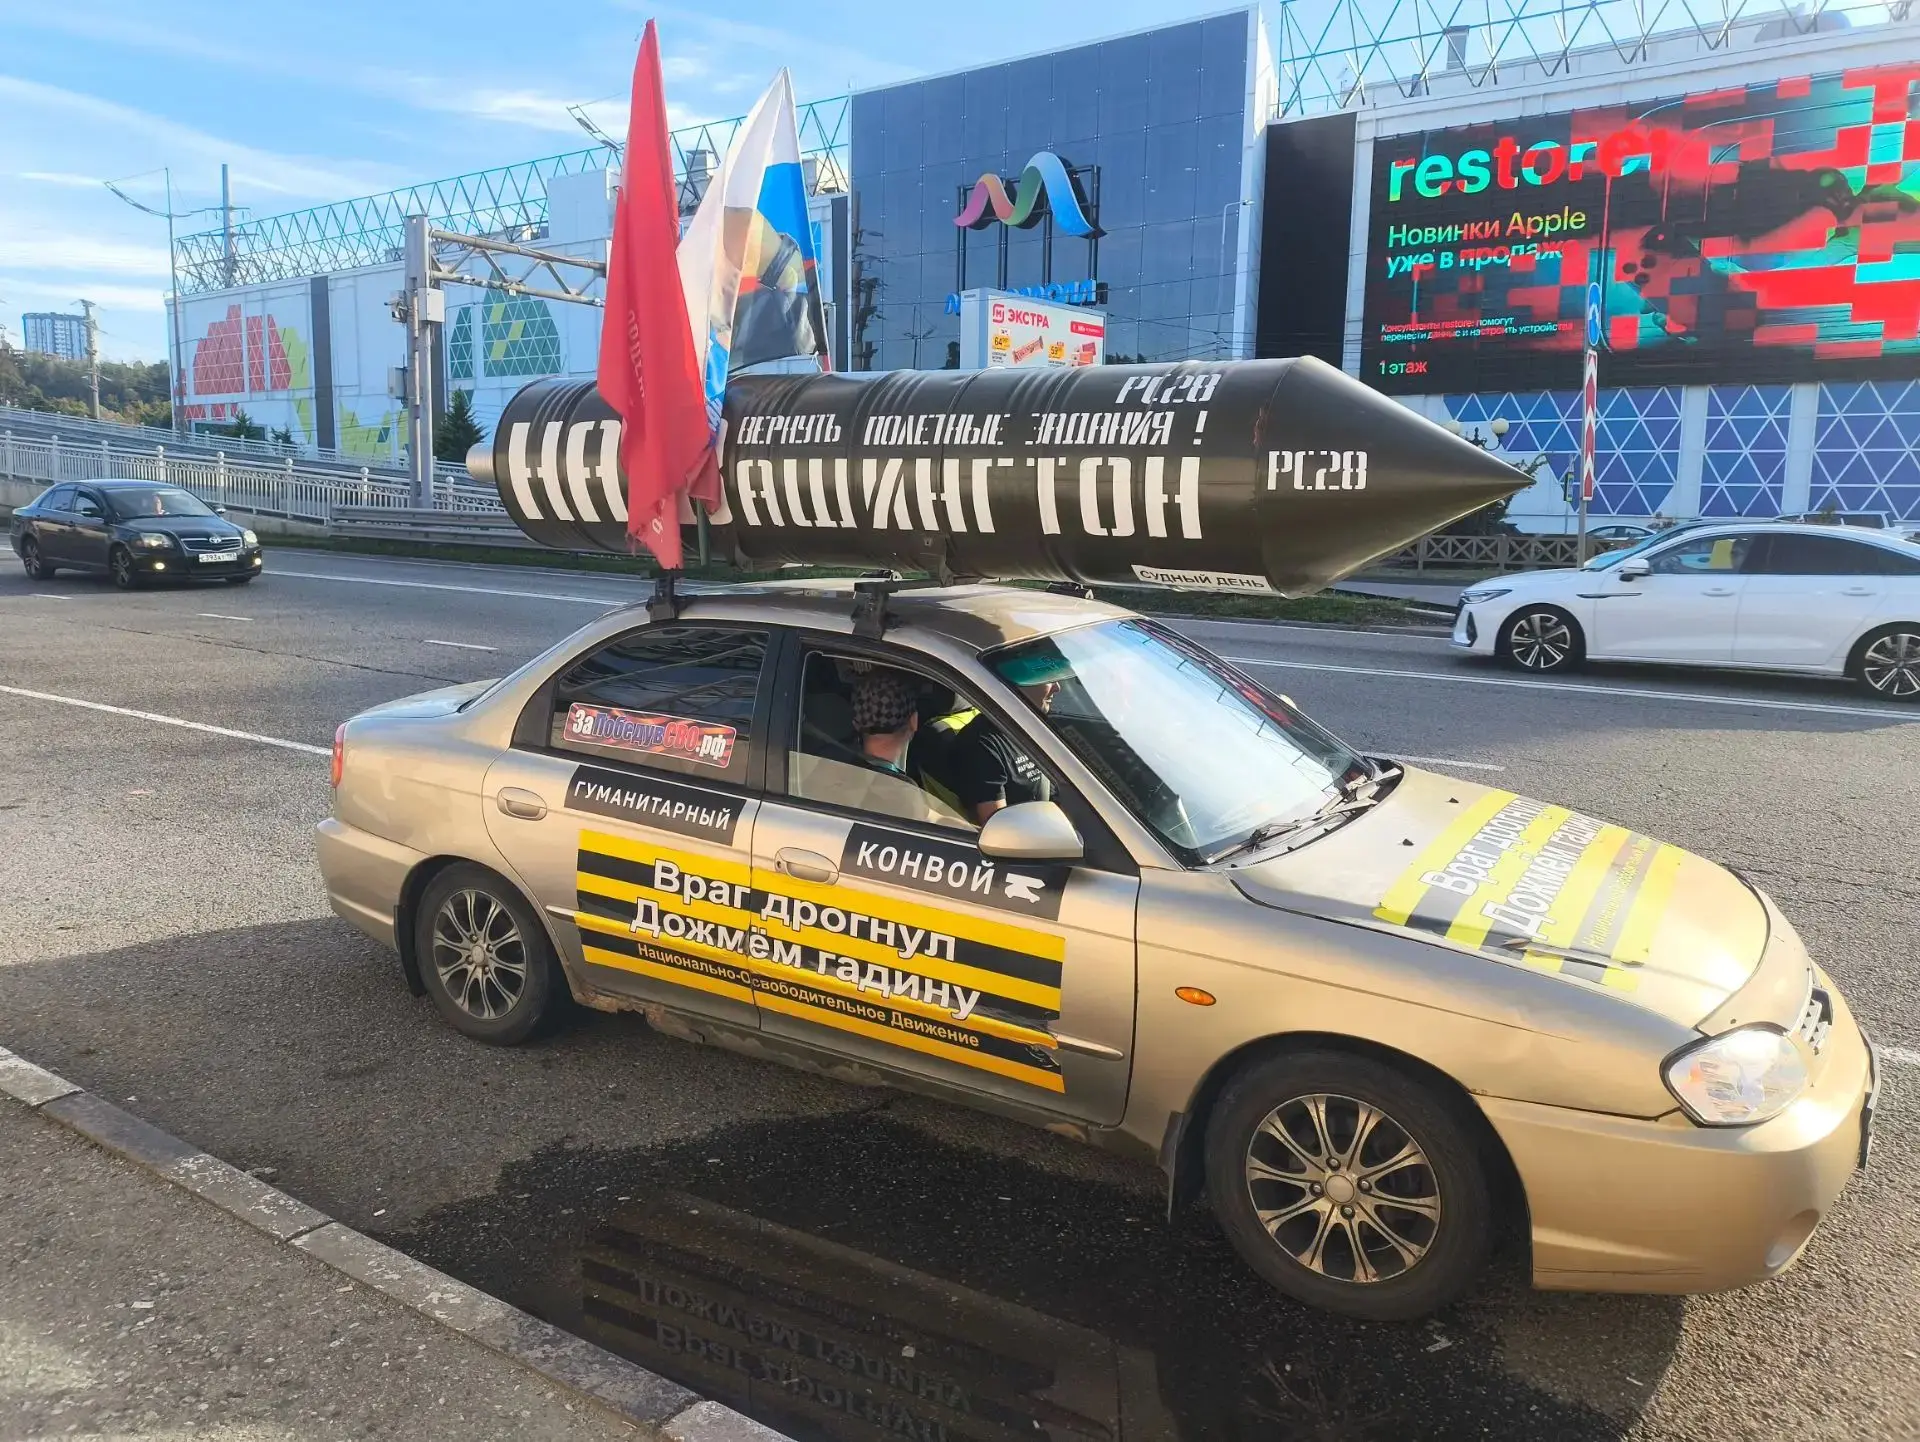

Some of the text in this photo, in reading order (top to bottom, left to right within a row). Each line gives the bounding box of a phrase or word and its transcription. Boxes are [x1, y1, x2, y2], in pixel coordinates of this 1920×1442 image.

[1388, 205, 1587, 248] Новинки Apple
[1439, 251, 1455, 269] в
[1008, 308, 1050, 329] ЭКСТРА
[1378, 360, 1428, 375] 1 этаж
[737, 413, 842, 446] ВЕРНУТЬ
[1024, 410, 1174, 446] ЗАДАНИЯ
[678, 416, 1204, 541] АШИНГТОН
[1139, 570, 1265, 588] СУДНЫЙ ДЕНЬ
[573, 780, 731, 831] ГУМАНИТАРНЫЙ
[856, 840, 996, 896] КОНВОЙ
[1419, 845, 1500, 897] Враг
[653, 857, 957, 962] Враг дрогнул
[629, 896, 981, 1021] Дожмём гадину
[637, 943, 980, 1048] Национально-Освободительное Движение
